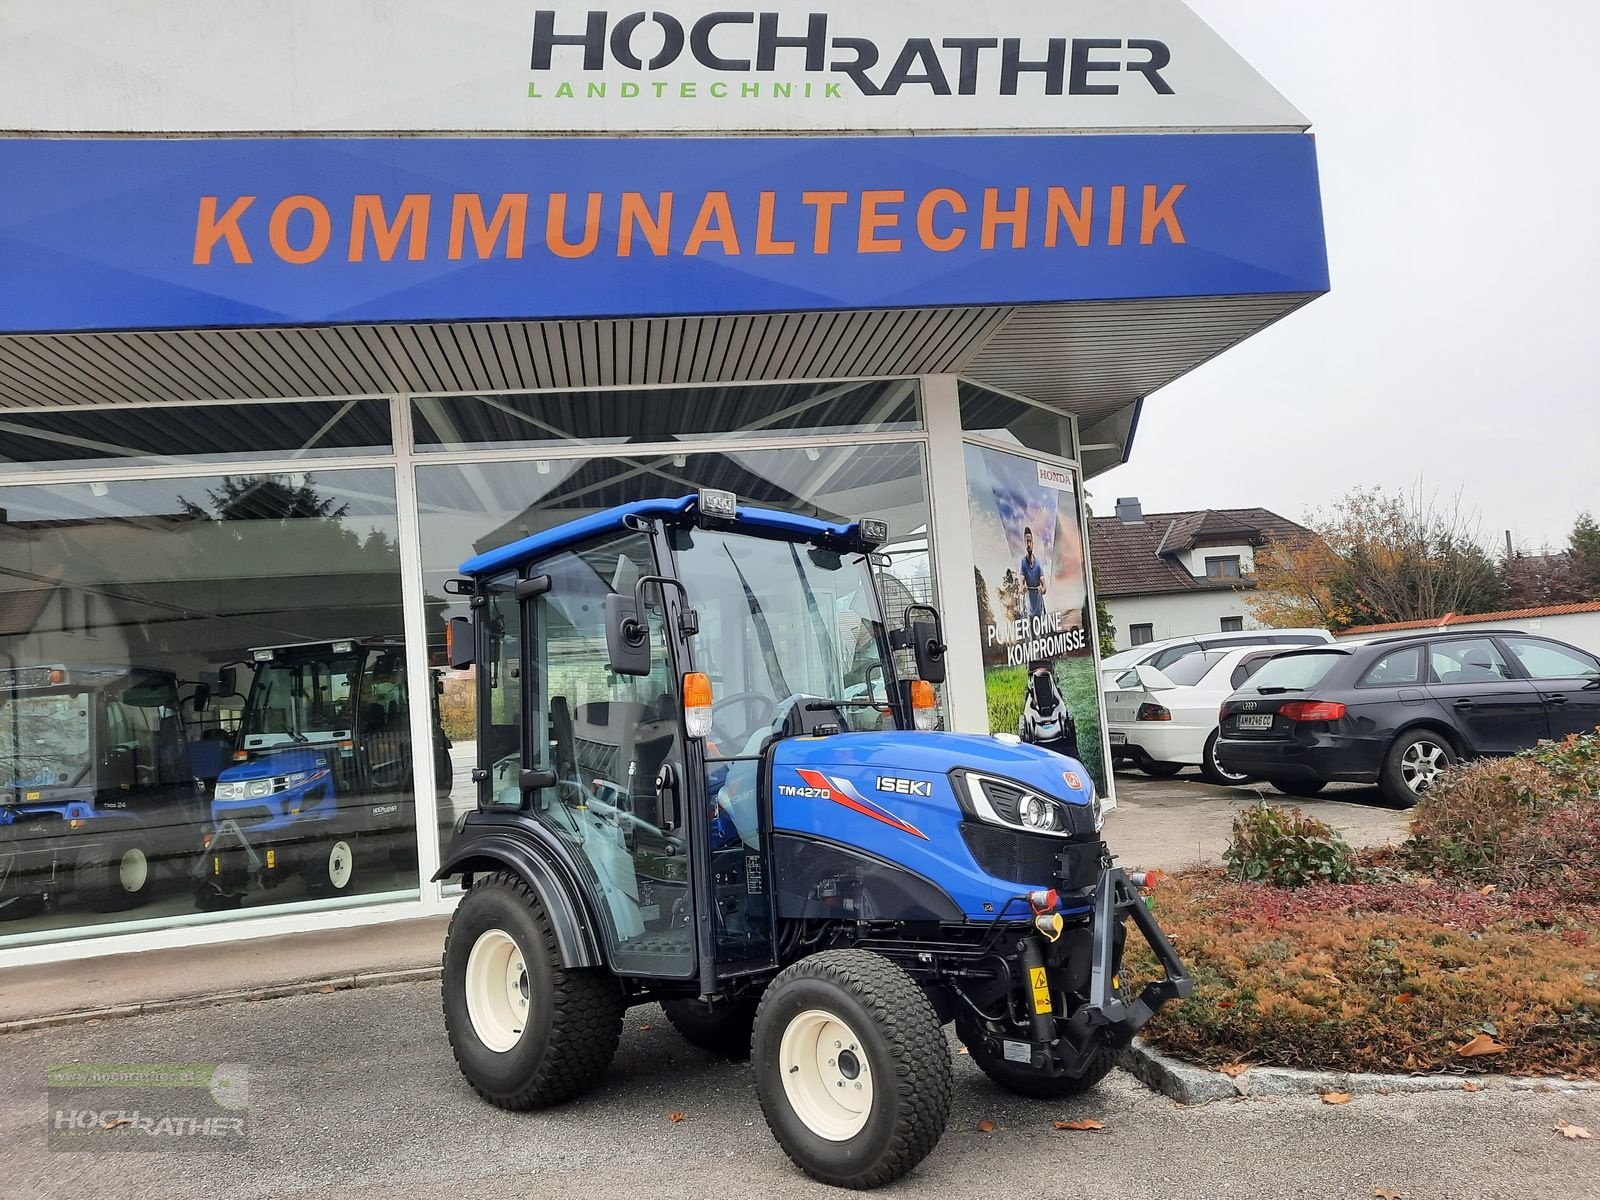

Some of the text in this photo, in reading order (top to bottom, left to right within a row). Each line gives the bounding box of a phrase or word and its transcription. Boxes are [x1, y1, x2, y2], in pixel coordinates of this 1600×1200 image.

[531, 10, 1176, 96] HOCHRATHER
[528, 81, 842, 98] LANDTECHNIK
[193, 184, 1187, 265] KOMMUNALTECHNIK
[1039, 469, 1072, 485] HONDA
[988, 611, 1062, 647] POWER OHNE
[1007, 628, 1086, 668] KOMPROMISSE
[778, 785, 831, 800] TM4270
[876, 775, 932, 797] ISEKI
